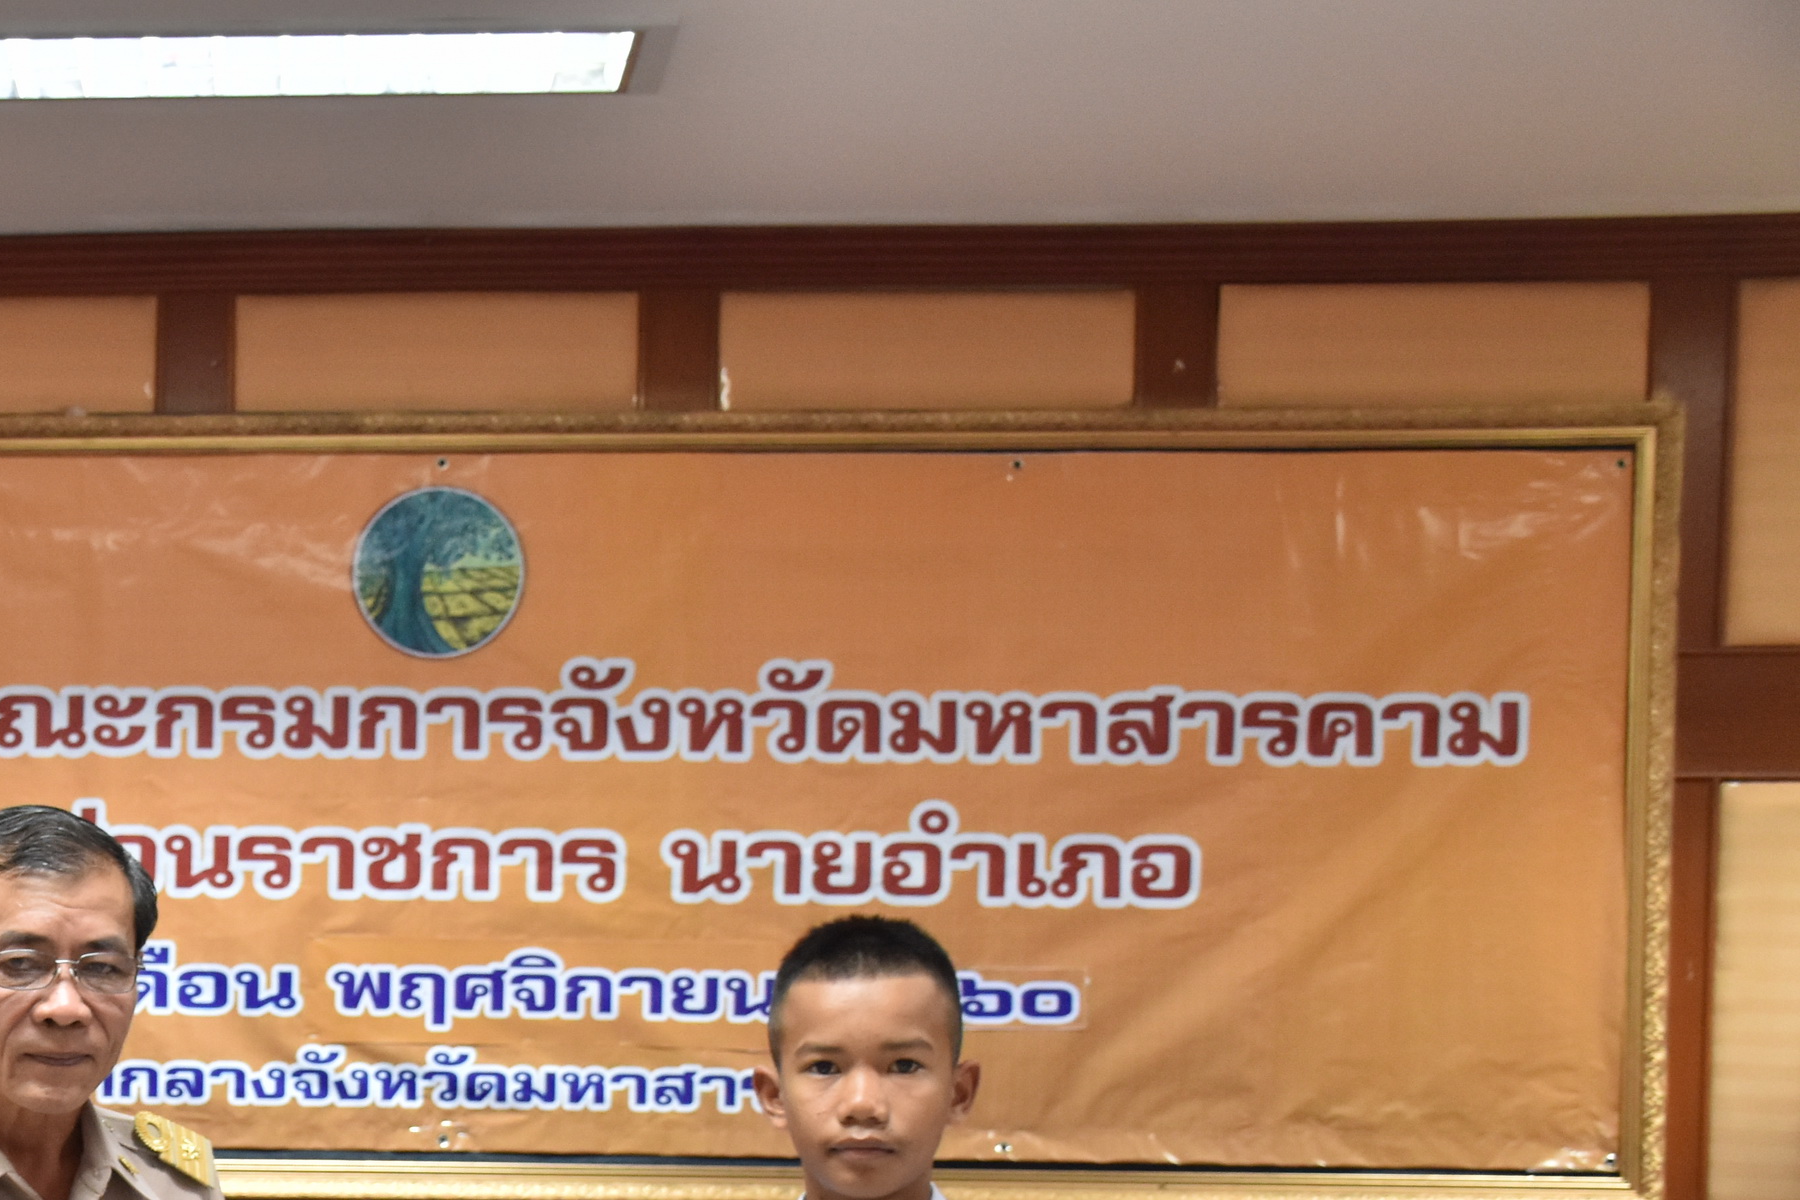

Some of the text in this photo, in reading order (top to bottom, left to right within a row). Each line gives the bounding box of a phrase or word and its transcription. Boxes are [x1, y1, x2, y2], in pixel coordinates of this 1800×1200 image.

[668, 800, 1203, 908] นายอำเภอ
[330, 945, 775, 1032] พฤศจิกายน
